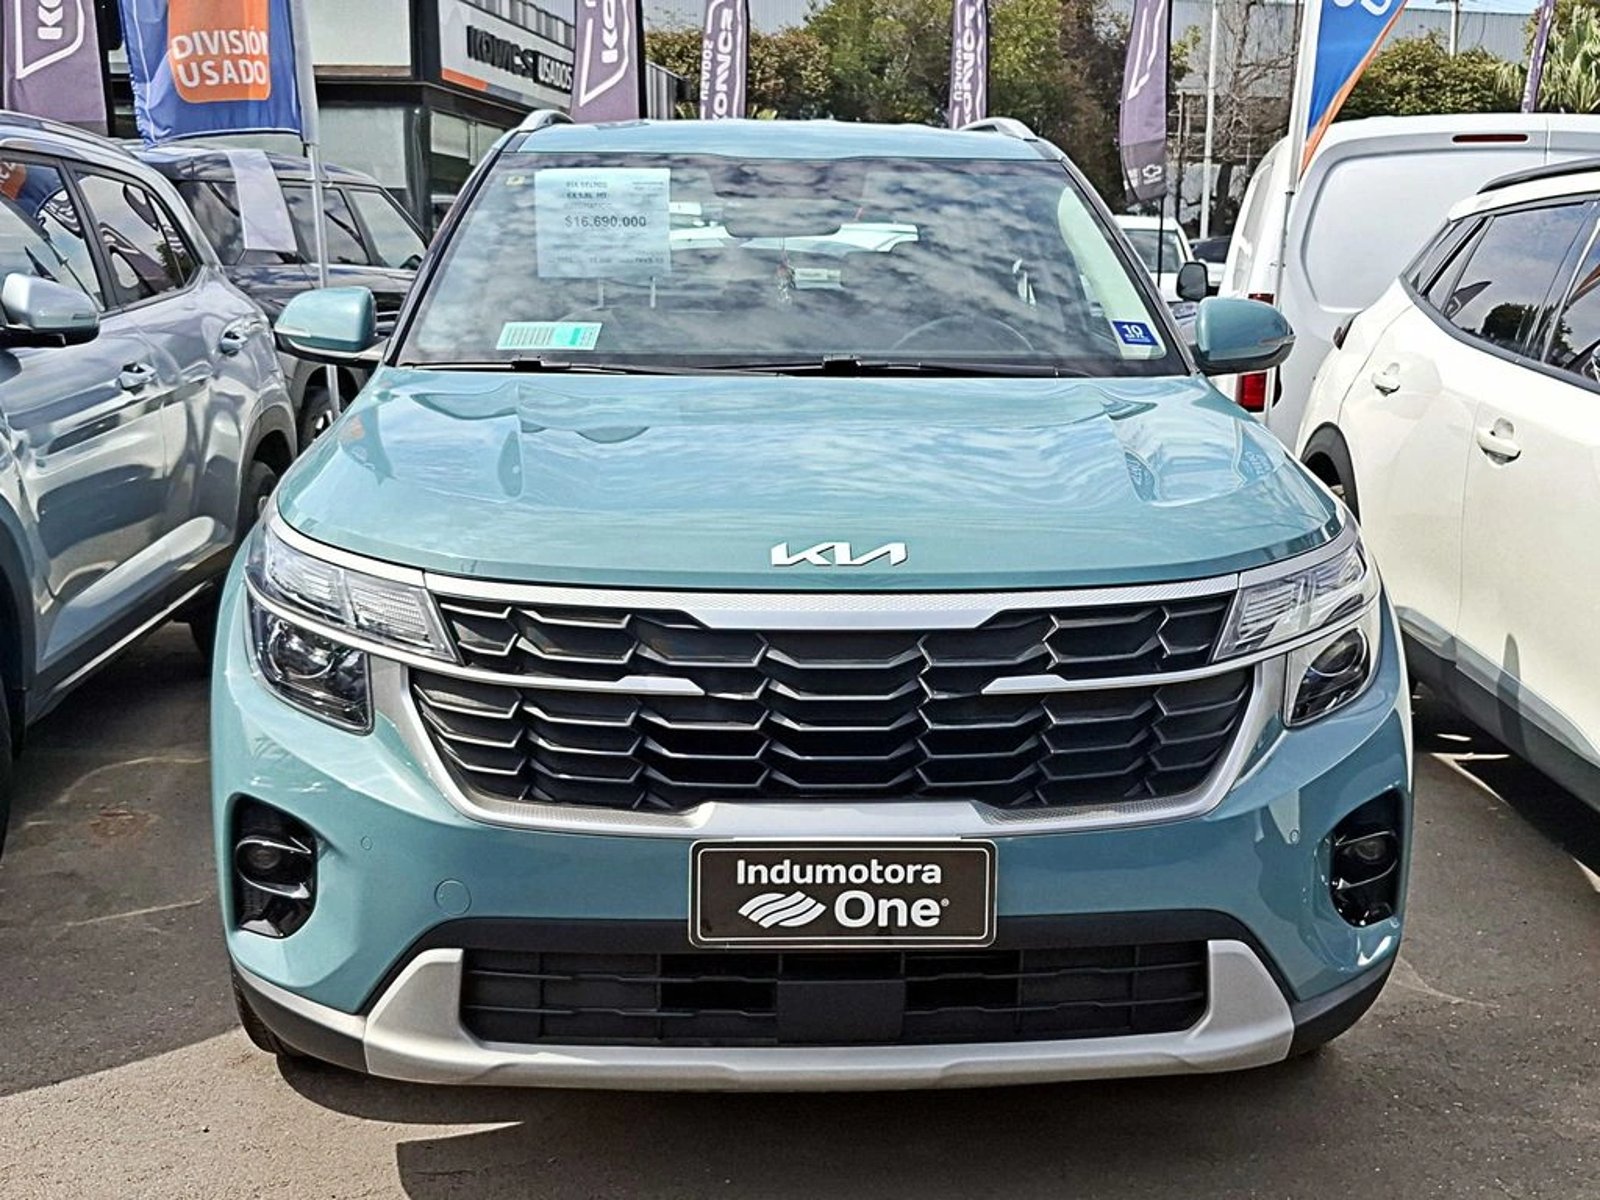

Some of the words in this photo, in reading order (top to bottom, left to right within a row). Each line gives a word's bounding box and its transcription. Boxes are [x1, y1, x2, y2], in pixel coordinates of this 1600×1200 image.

[565, 215, 647, 227] $16.690.000
[771, 541, 907, 567] KIA
[736, 859, 942, 884] Indumotora
